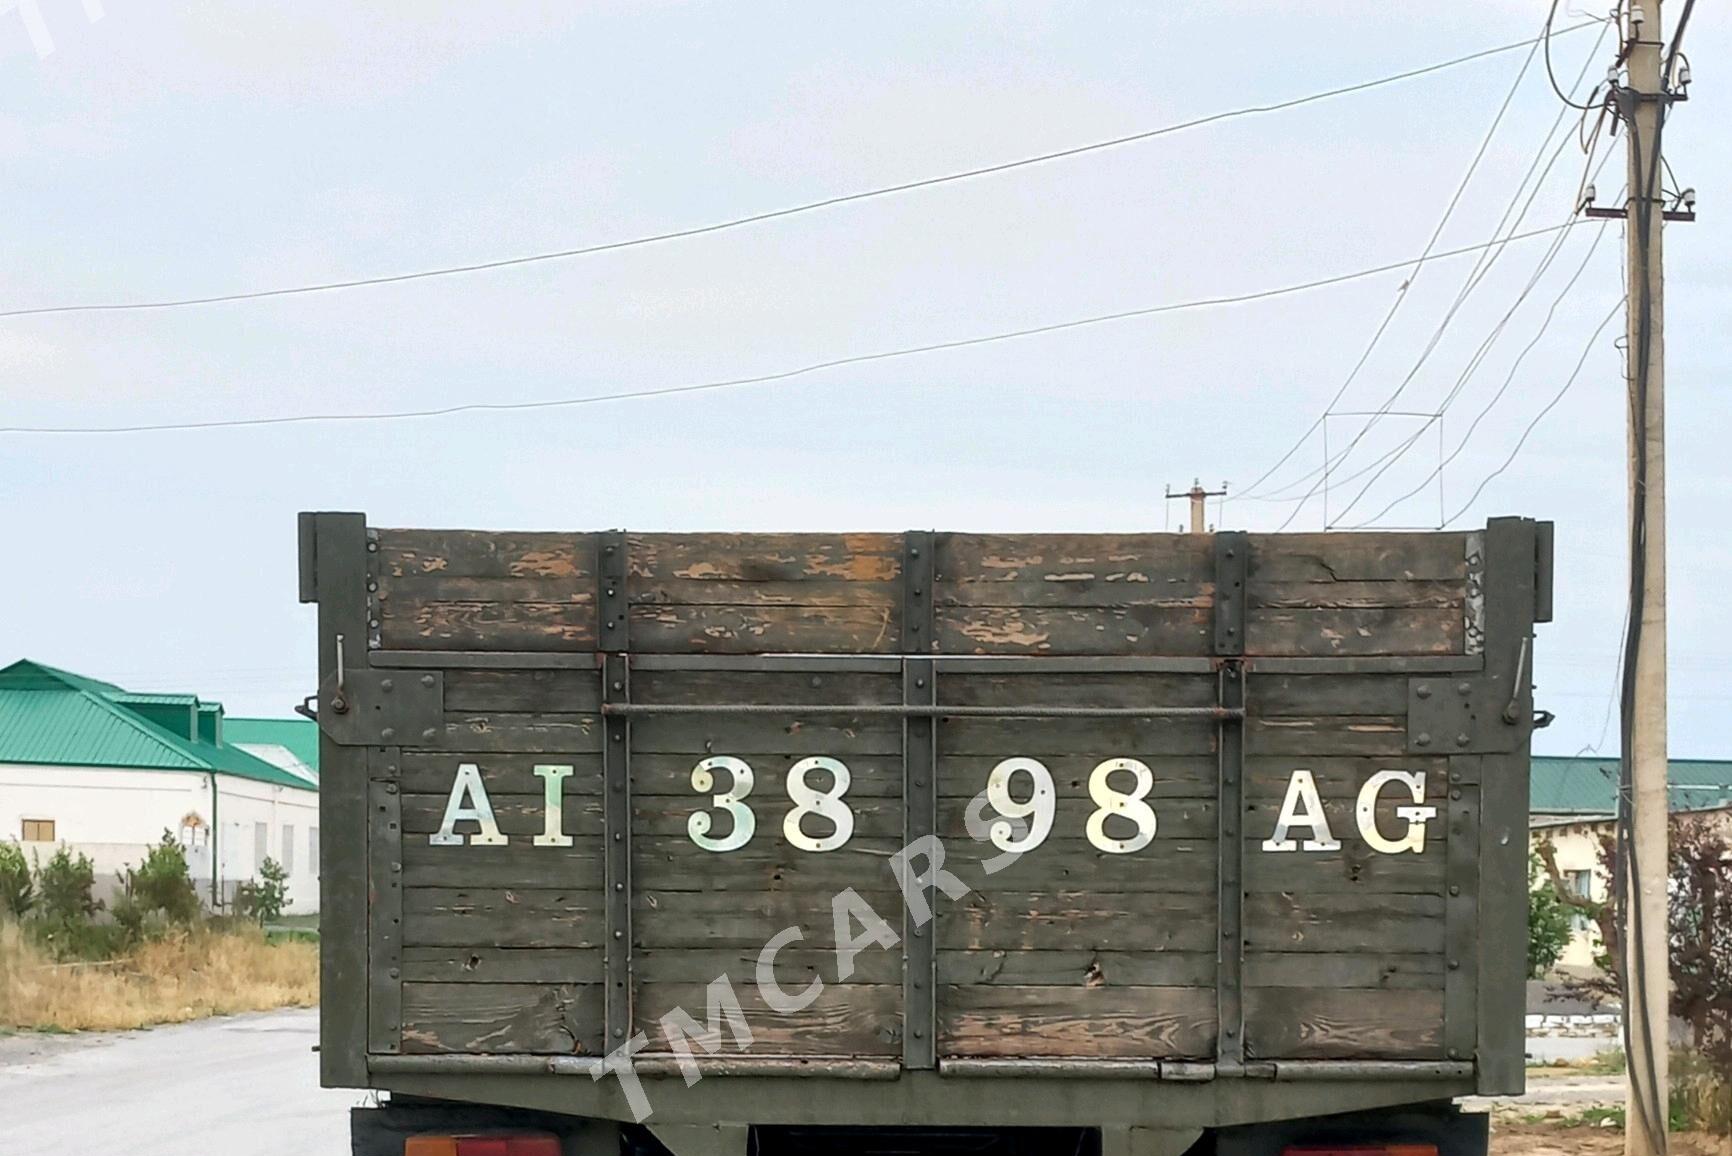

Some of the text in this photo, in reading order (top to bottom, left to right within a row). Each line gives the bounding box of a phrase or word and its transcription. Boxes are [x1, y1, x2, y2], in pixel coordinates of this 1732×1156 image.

[429, 755, 1437, 854] AI 38 98 AG
